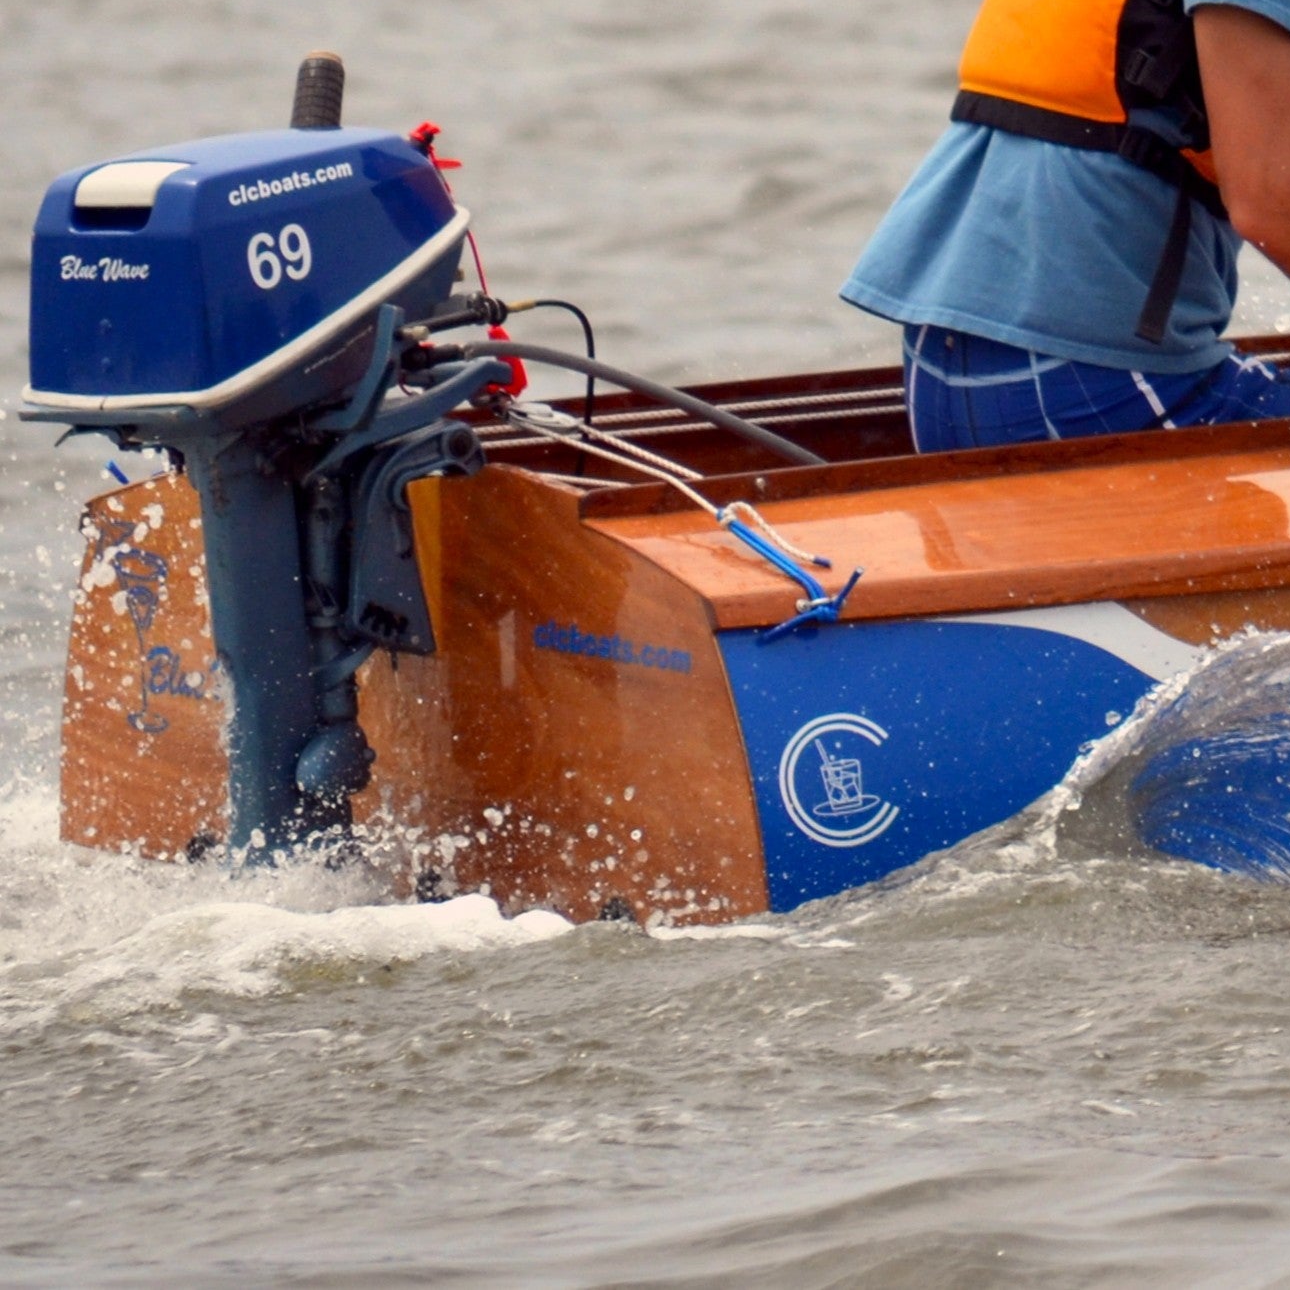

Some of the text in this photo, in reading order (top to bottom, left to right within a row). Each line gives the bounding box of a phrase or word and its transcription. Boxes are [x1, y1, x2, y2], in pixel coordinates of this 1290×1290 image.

[228, 162, 353, 206] clcboats.com
[60, 255, 150, 282] Blue Wave
[247, 223, 313, 289] 69
[533, 619, 692, 674] clcboats.com
